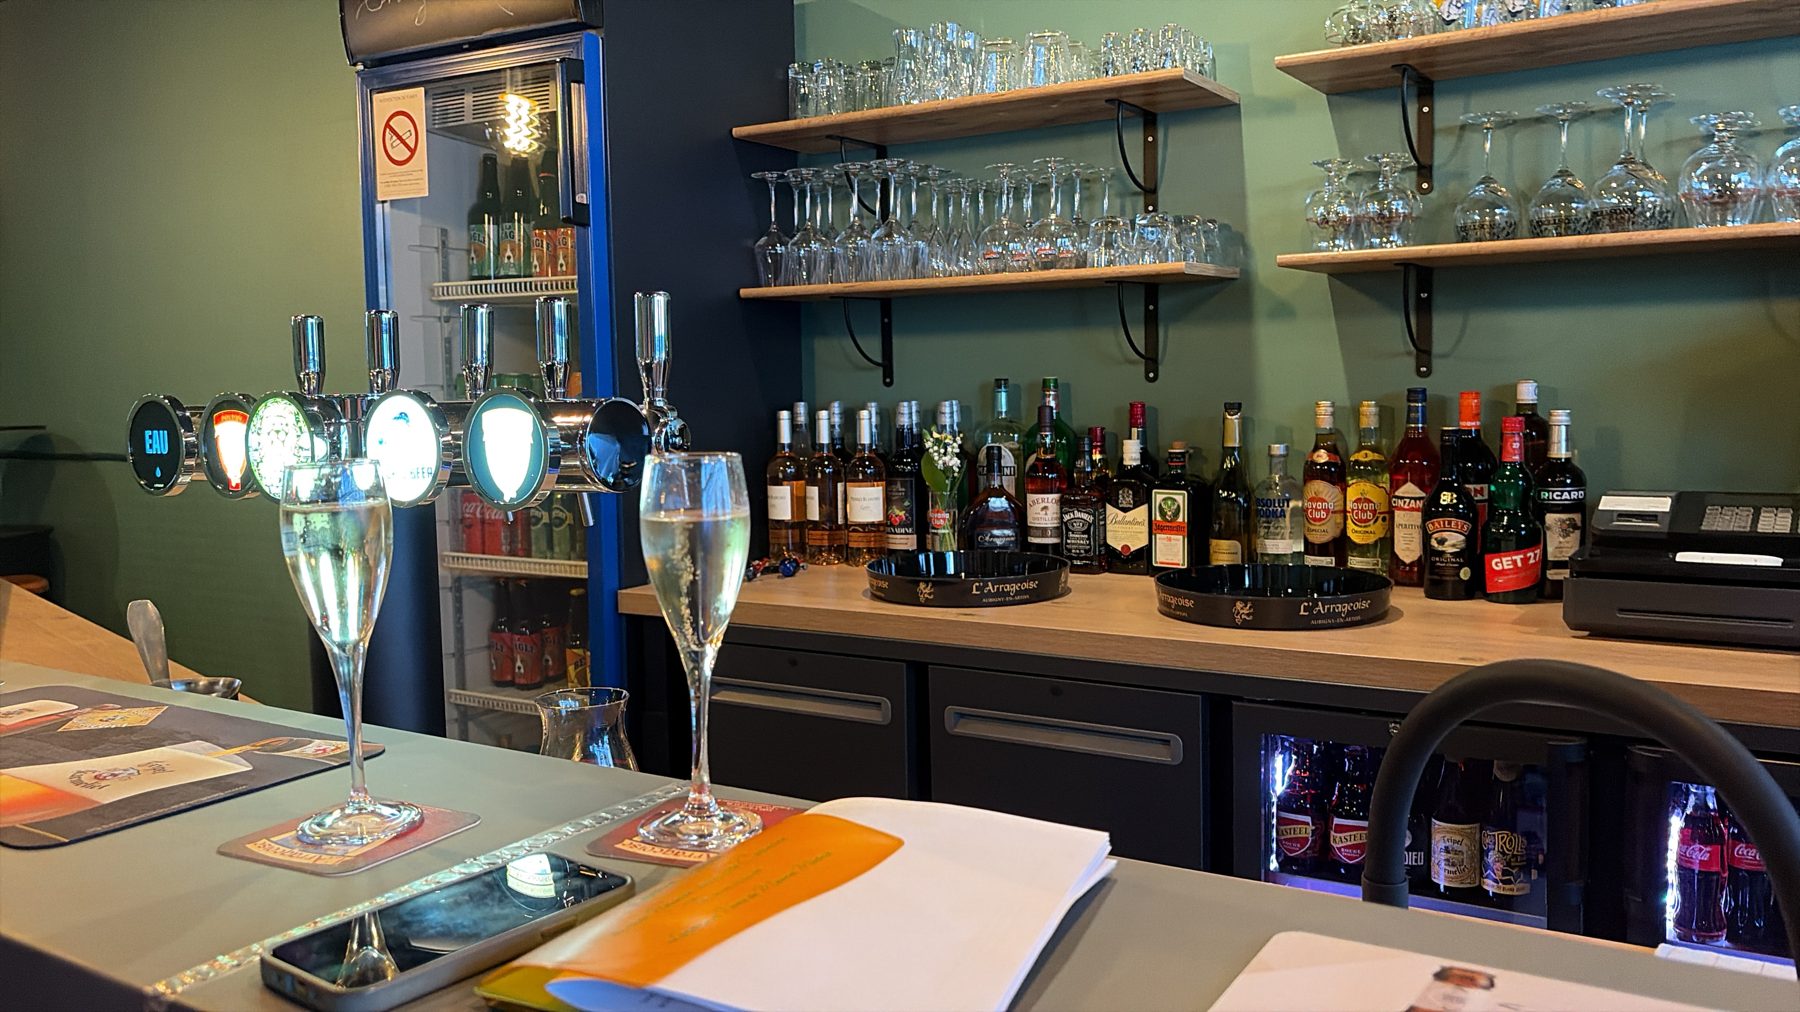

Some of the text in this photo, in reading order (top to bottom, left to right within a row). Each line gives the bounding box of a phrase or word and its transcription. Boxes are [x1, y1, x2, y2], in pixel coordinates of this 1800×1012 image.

[144, 430, 169, 454] EAU
[1540, 490, 1585, 500] RICARD
[1028, 497, 1060, 508] ABERLO
[1256, 498, 1290, 508] BSOLUT
[1391, 498, 1423, 509] CINZAN
[1062, 511, 1074, 522] JACK
[1307, 509, 1327, 519] Club
[1353, 509, 1374, 520] Club
[1427, 519, 1469, 532] BAILEYS
[1491, 549, 1541, 571] GET 27
[971, 579, 1039, 596] L'Arrageoise
[1299, 598, 1372, 617] L'Arrageoise
[1279, 826, 1310, 837] ASTEEL
